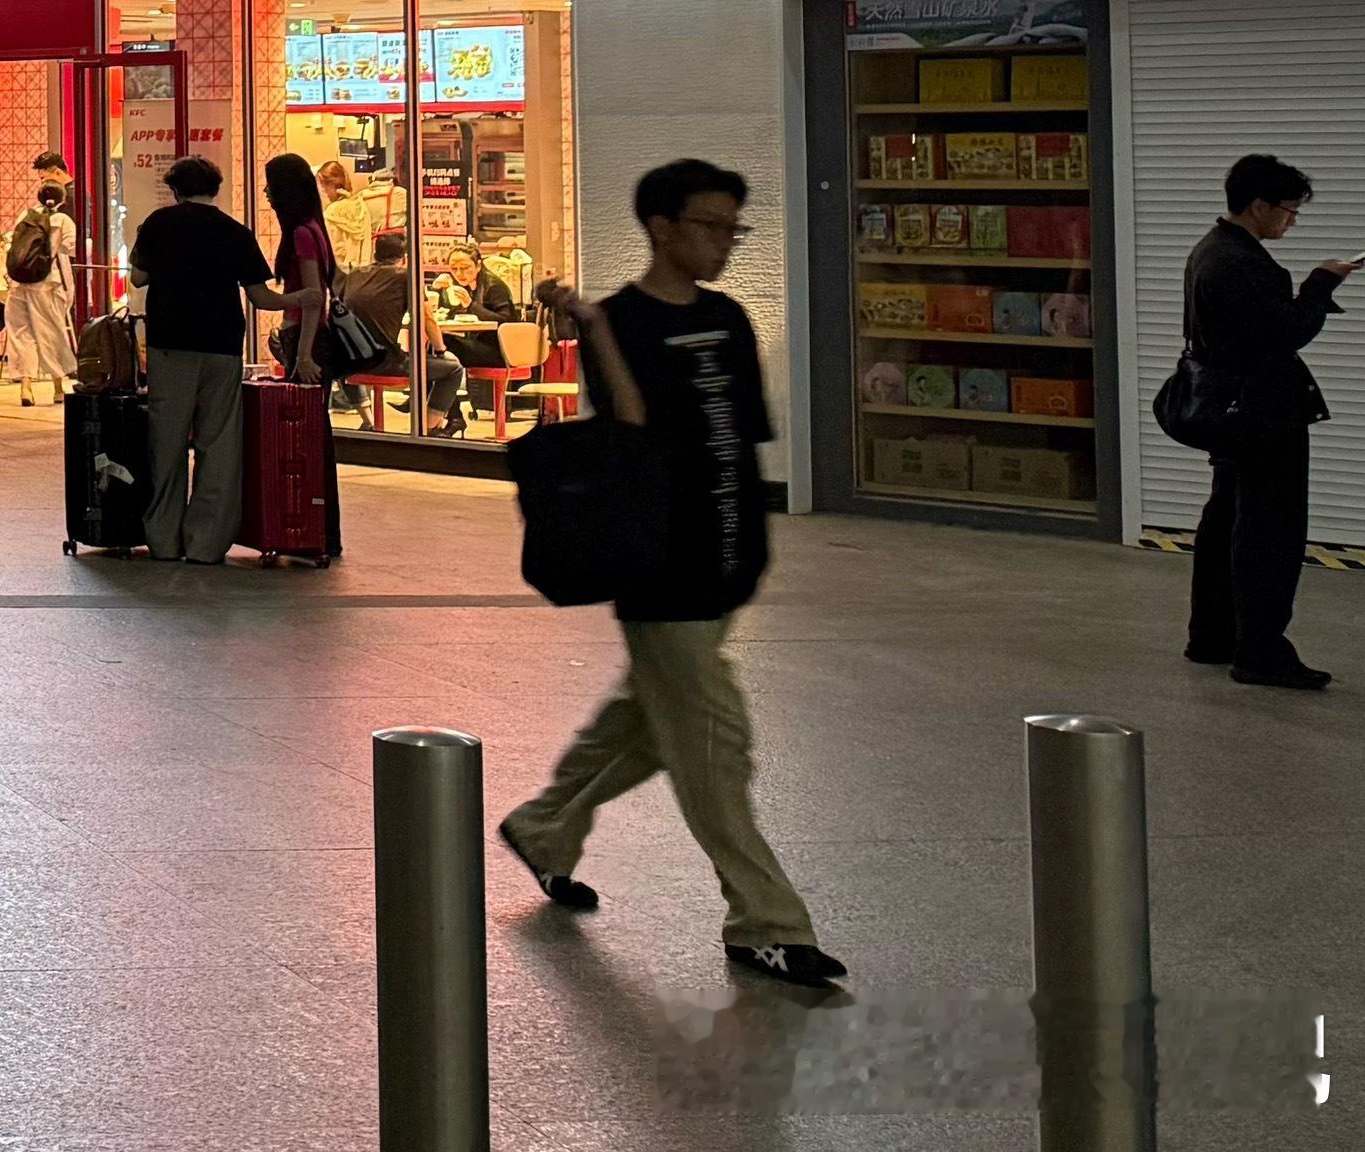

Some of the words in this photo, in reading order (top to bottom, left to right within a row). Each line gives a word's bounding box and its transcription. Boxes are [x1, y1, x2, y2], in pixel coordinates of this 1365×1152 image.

[130, 127, 225, 142] APP专享惠套餐
